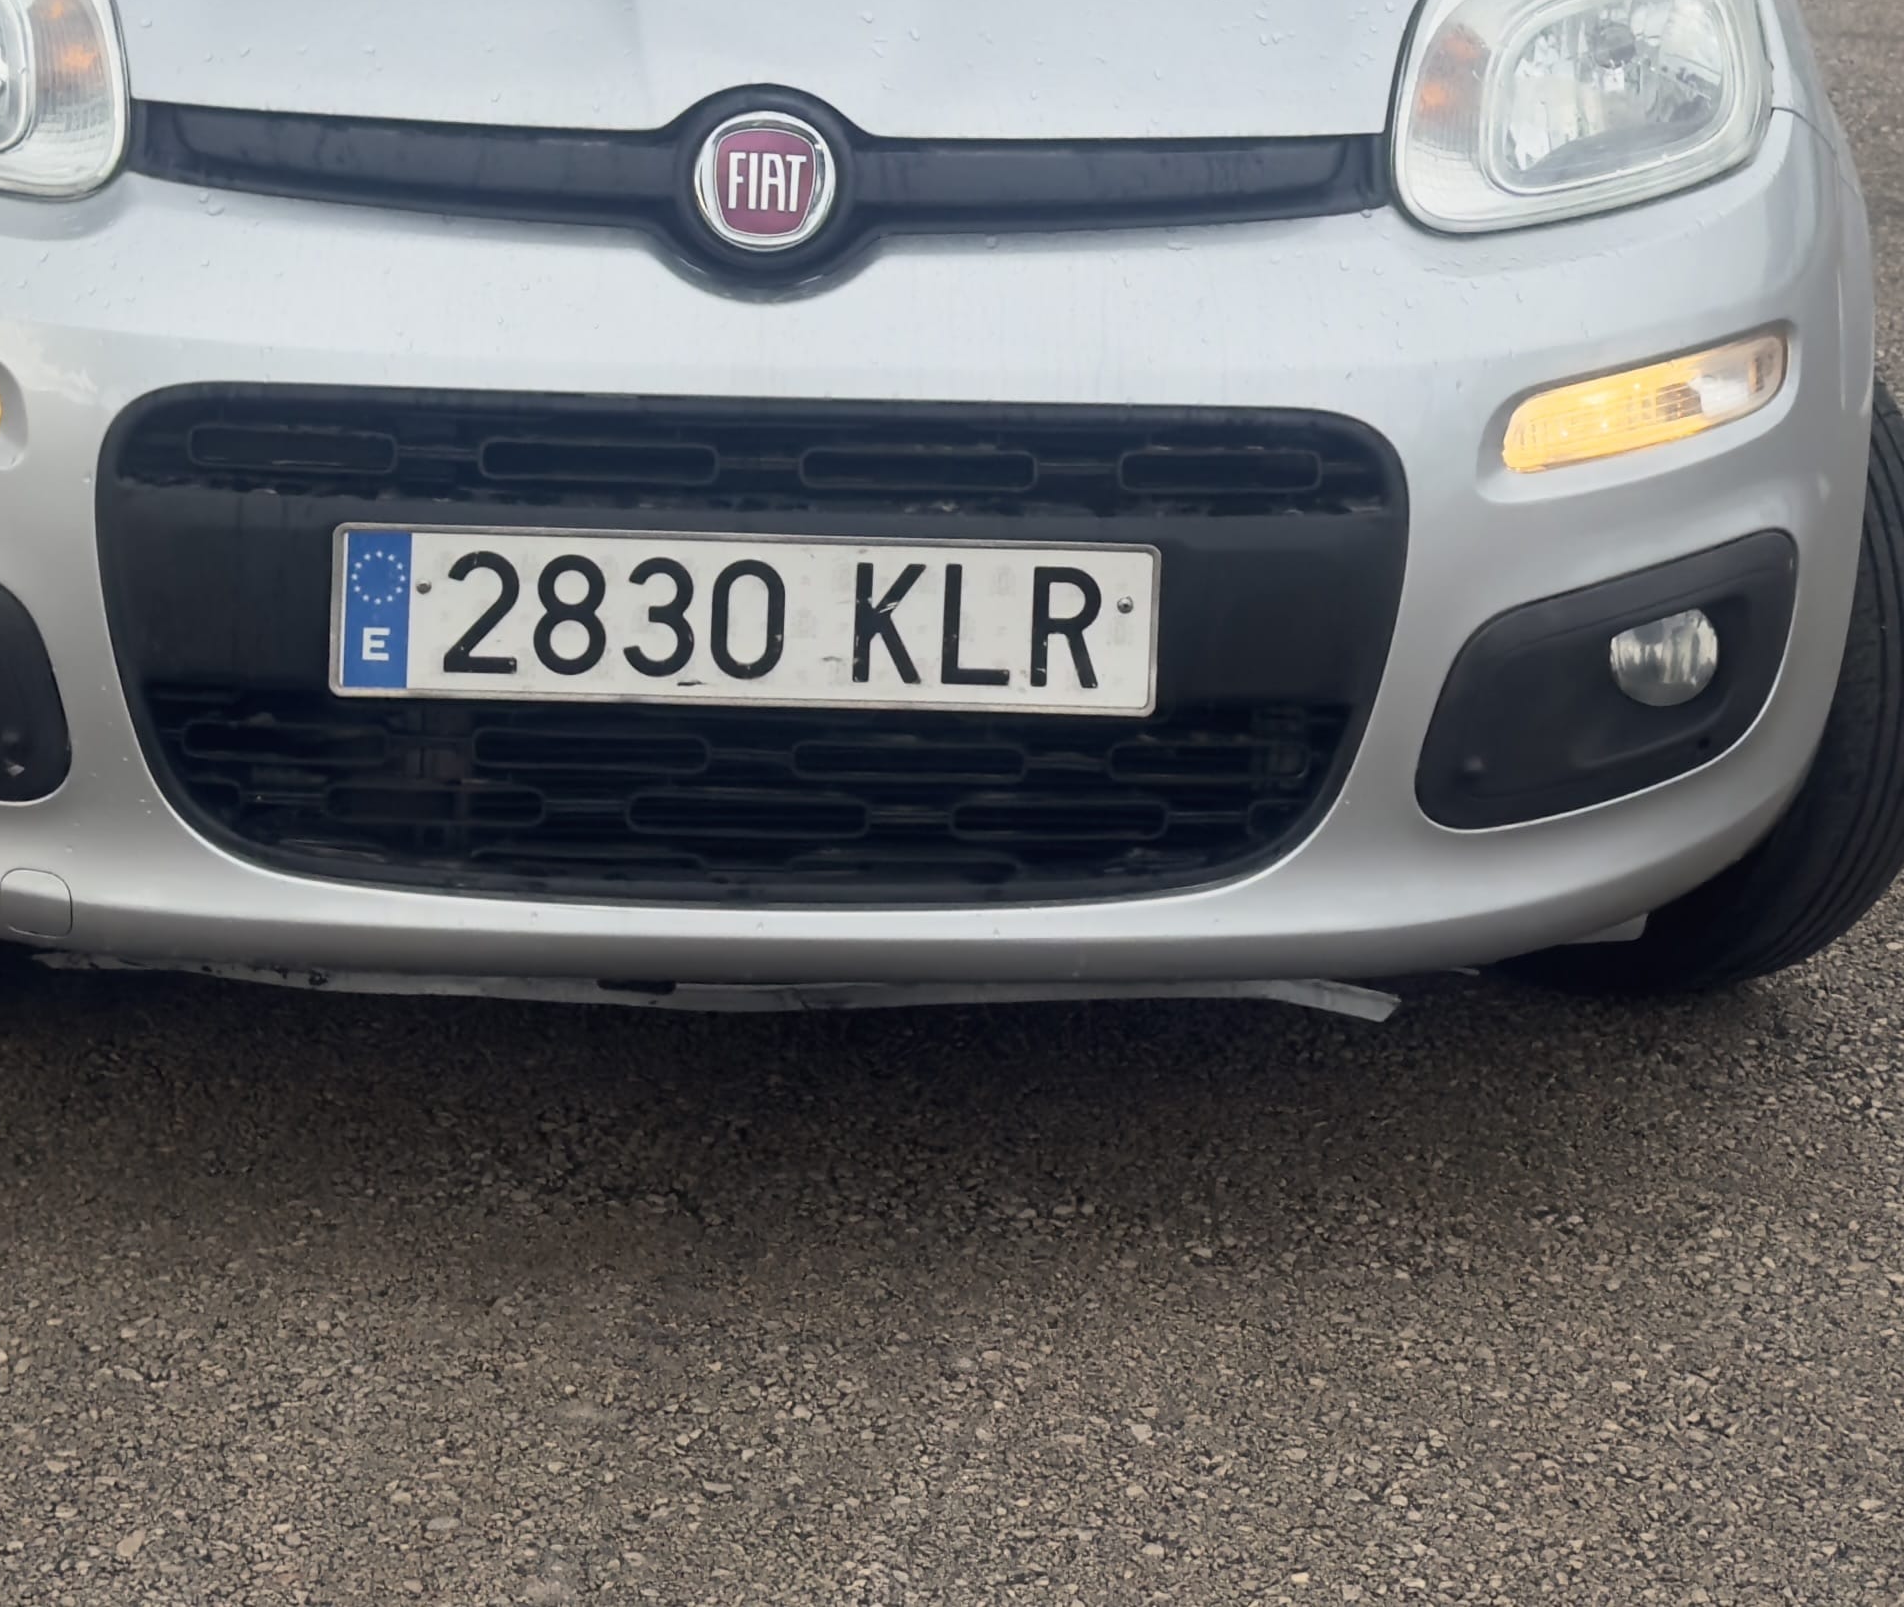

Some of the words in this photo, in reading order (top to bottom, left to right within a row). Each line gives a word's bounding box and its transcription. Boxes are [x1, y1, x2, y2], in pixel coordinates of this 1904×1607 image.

[727, 151, 807, 212] FIAT
[362, 627, 390, 661] E
[442, 550, 786, 680] 2830
[852, 562, 1103, 689] KLR
